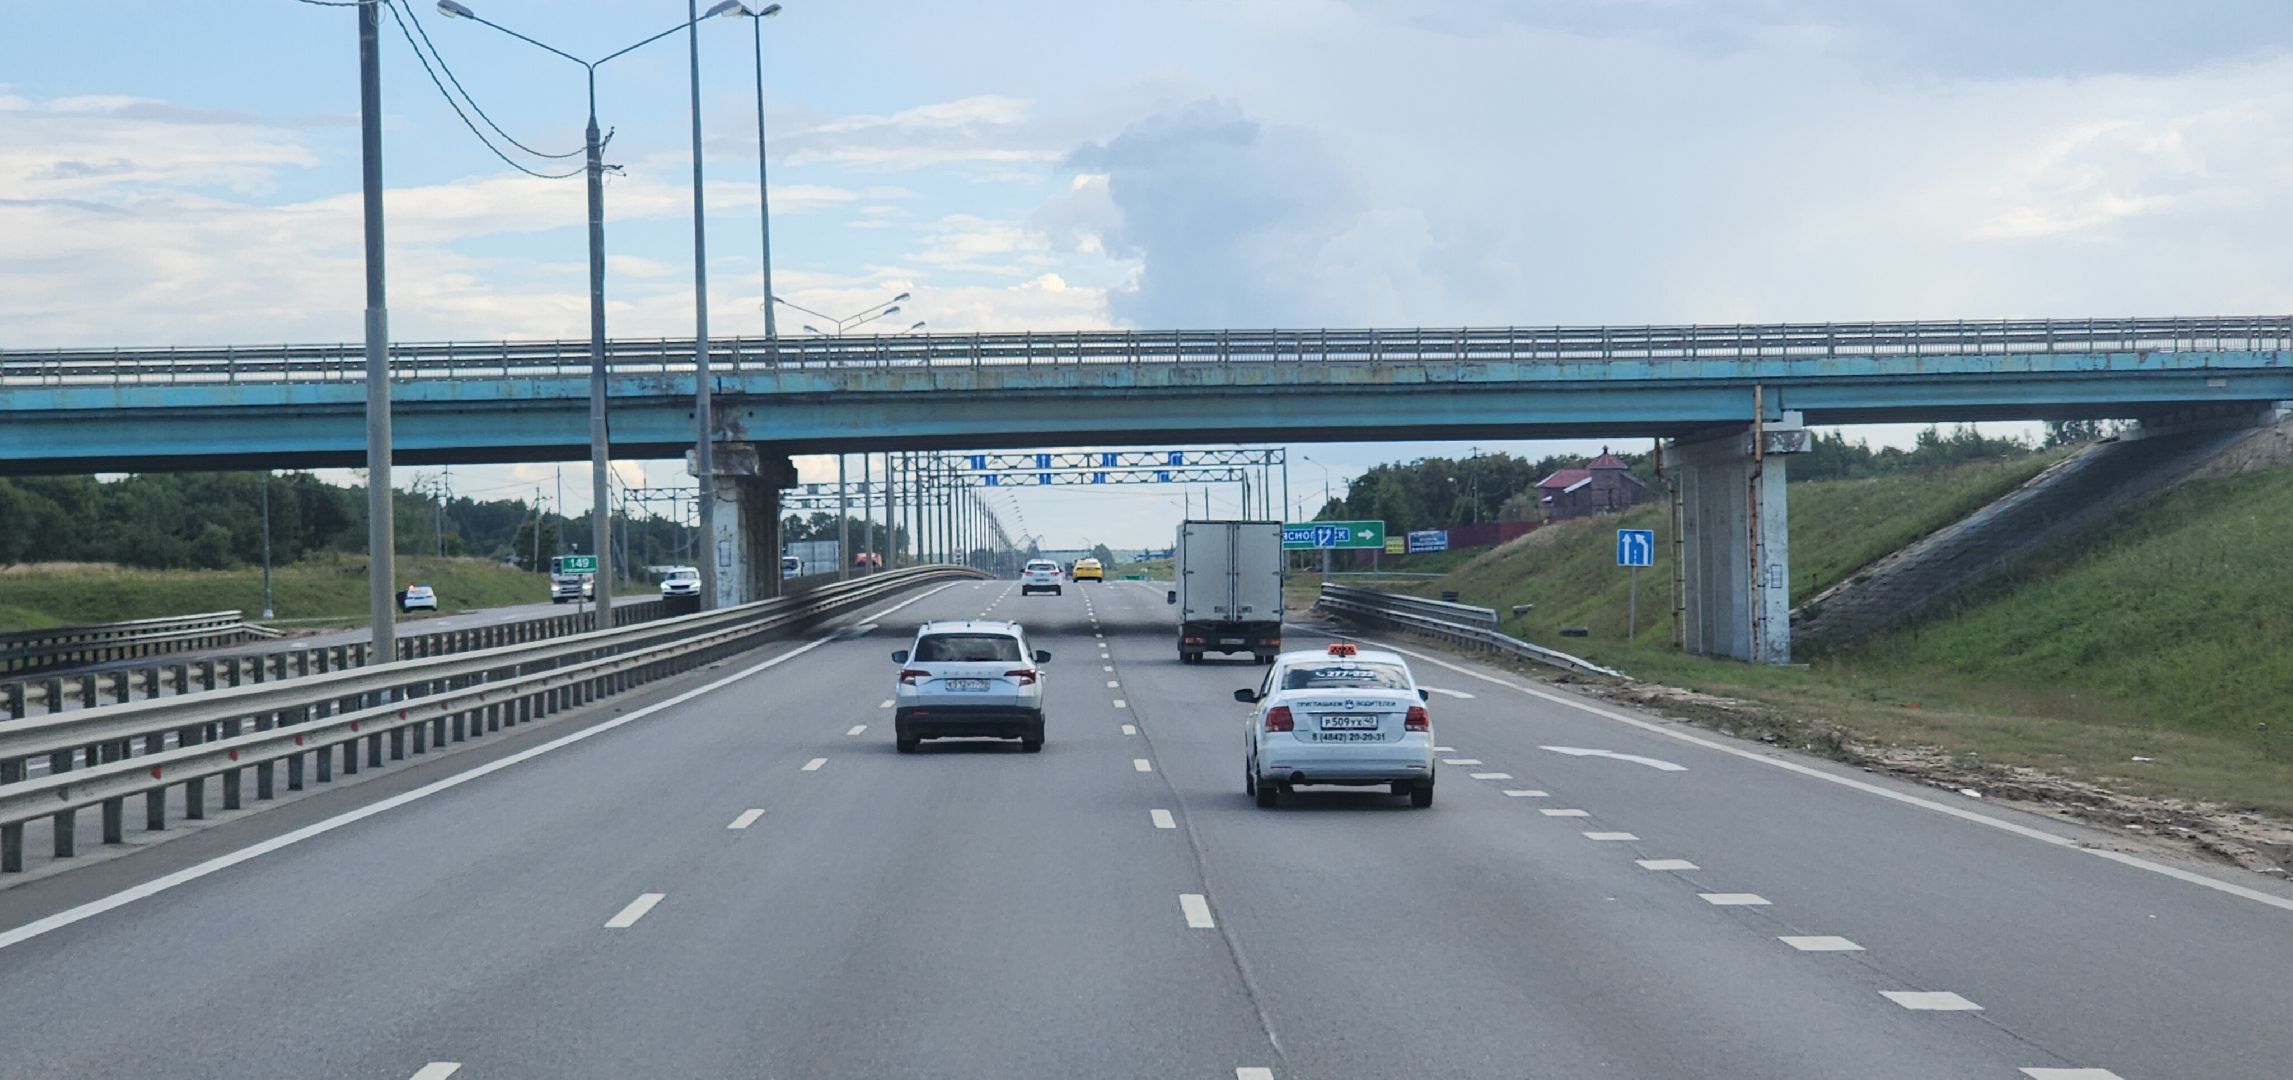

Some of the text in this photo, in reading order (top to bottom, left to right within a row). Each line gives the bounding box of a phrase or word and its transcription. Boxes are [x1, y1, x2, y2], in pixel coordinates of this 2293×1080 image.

[571, 559, 589, 567] 149
[1320, 733, 1346, 742] (4842)
[1349, 733, 1385, 741] 20-20-31
